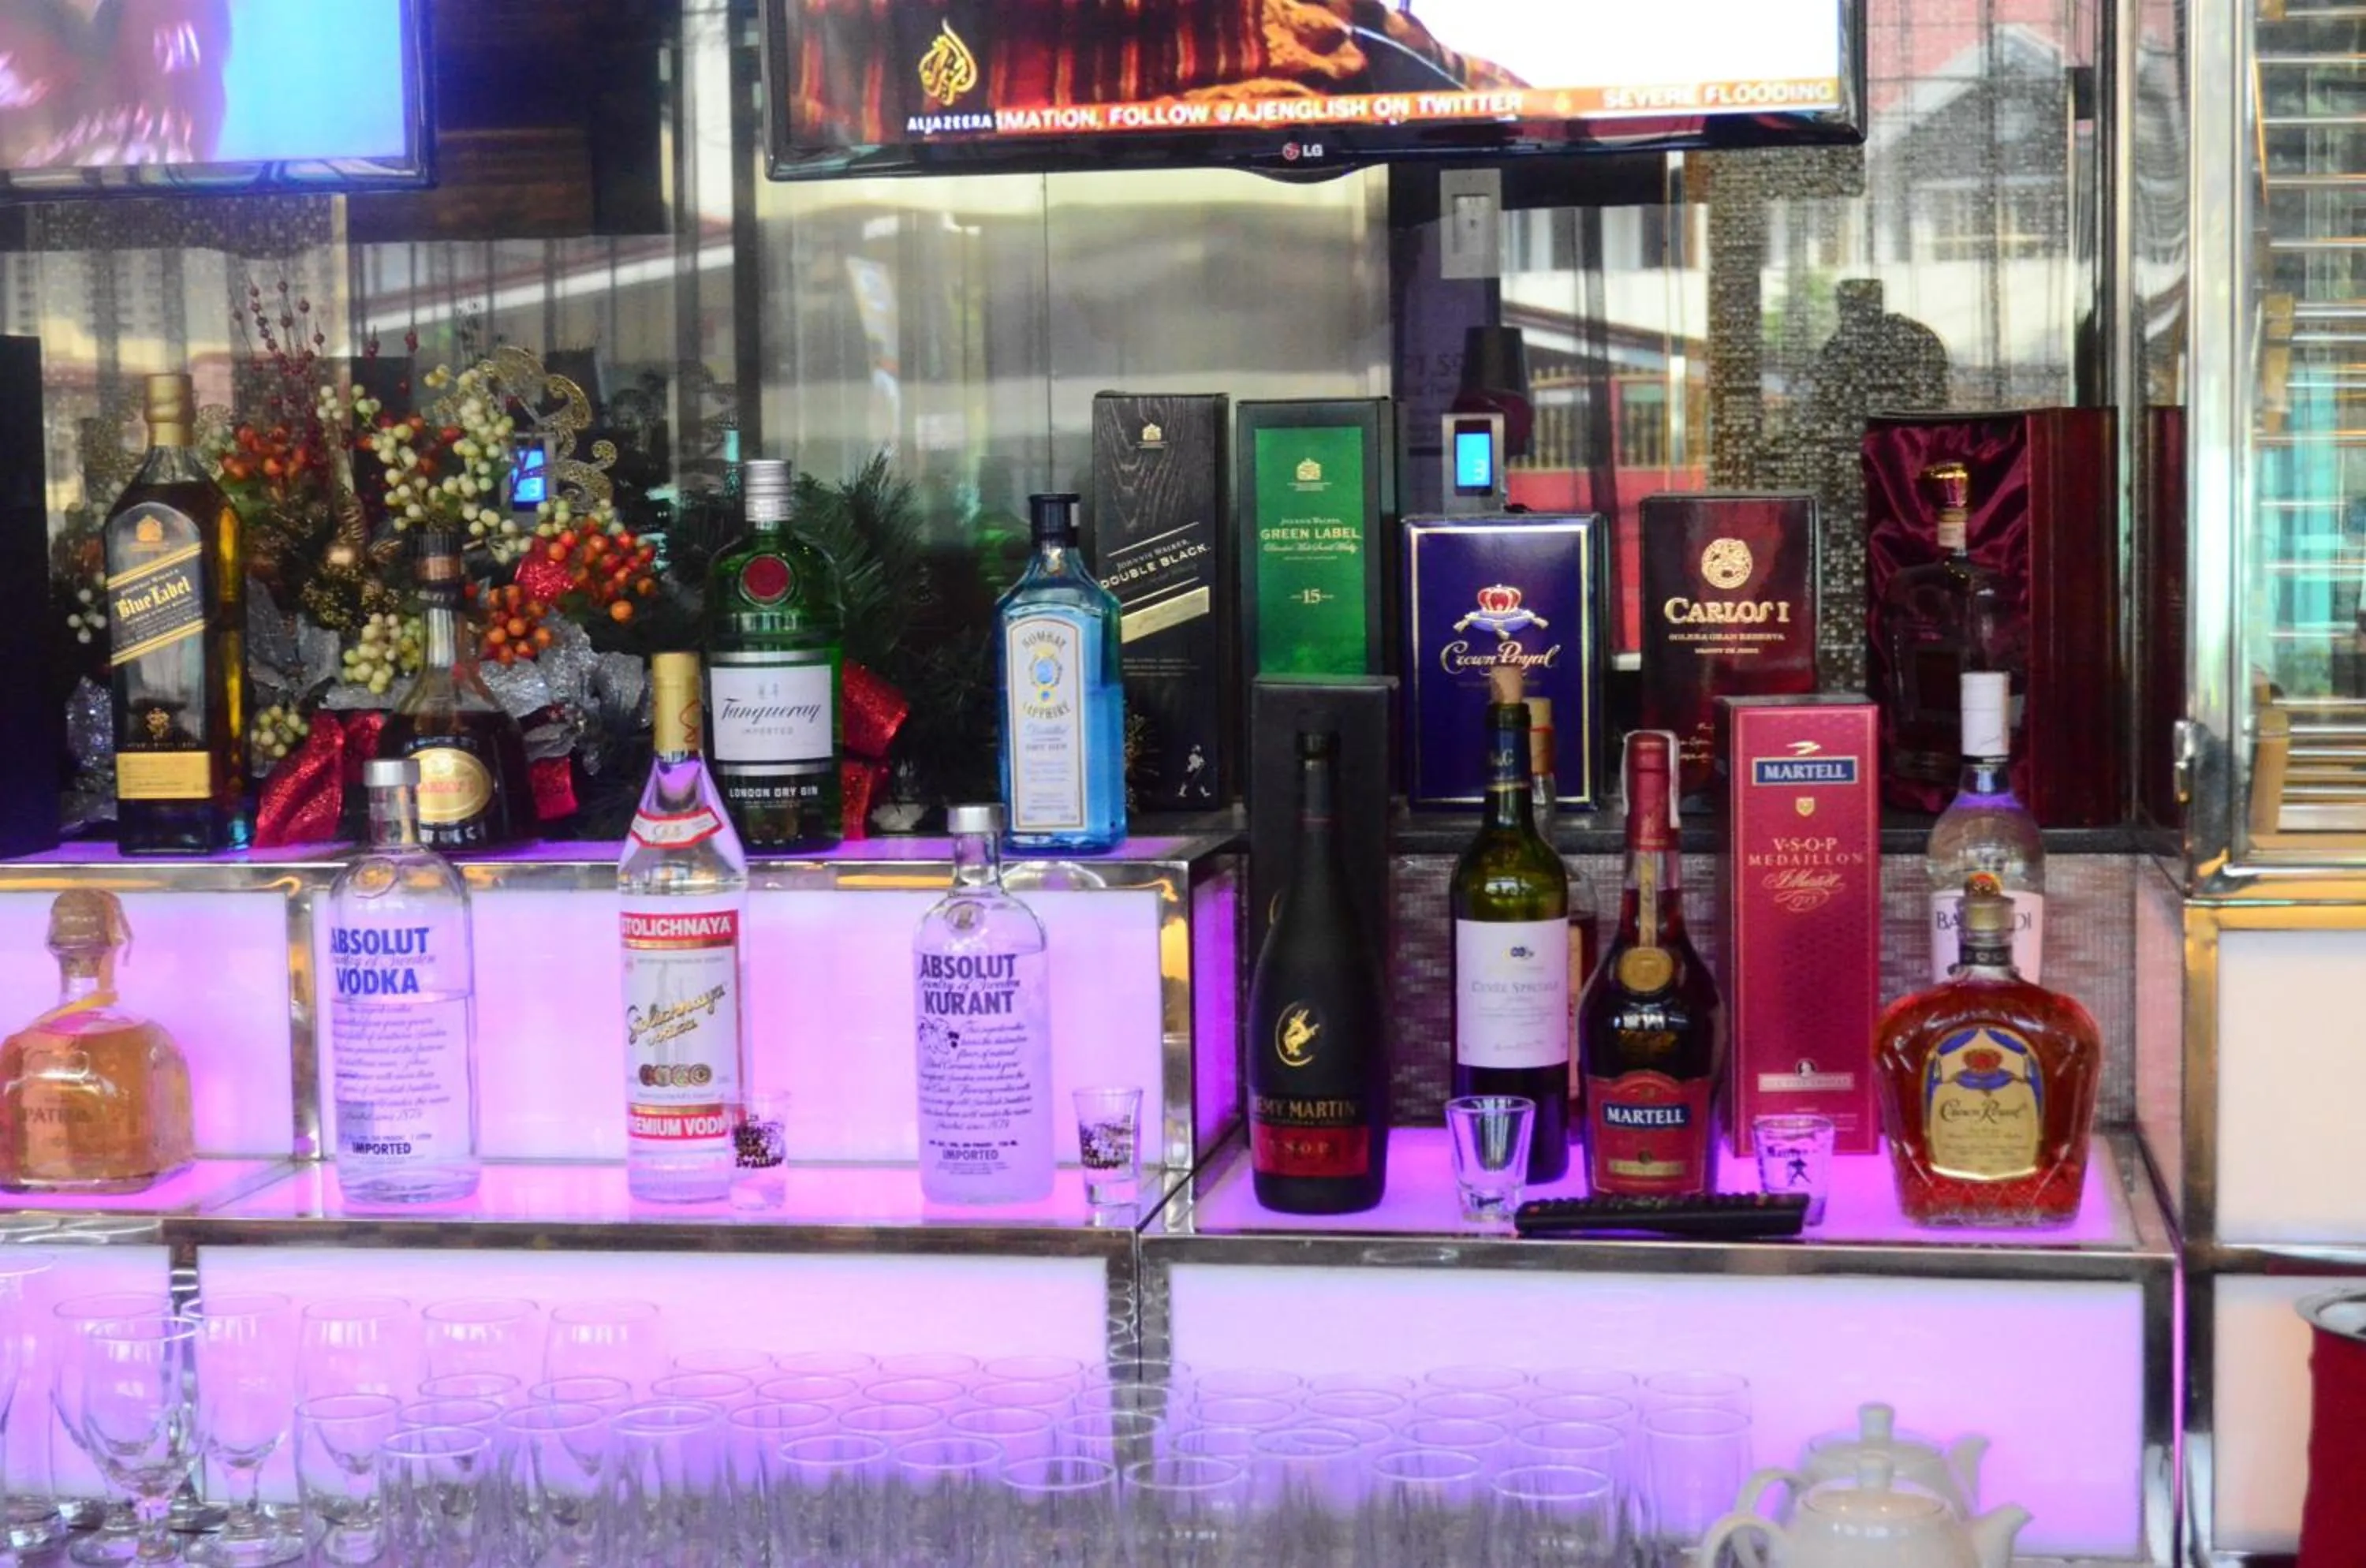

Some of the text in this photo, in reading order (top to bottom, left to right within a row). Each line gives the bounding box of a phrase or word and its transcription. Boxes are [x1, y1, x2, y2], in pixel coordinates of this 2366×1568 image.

[1109, 103, 1209, 126] FOLLOW
[1372, 96, 1410, 117] ON
[1416, 91, 1524, 114] TWITTER
[1602, 86, 1695, 108] SEVERE
[1704, 82, 1833, 104] FLOODING
[1302, 144, 1323, 157] LG
[1260, 527, 1362, 540] GREEN LABEL
[1099, 562, 1157, 590] DOUBLE
[114, 595, 152, 621] Blue
[149, 576, 192, 607] Label
[1302, 589, 1321, 604] 15
[1439, 640, 1561, 674] Crown Royal
[721, 697, 821, 724] Tanqueray
[1763, 763, 1847, 779] MARTELL
[730, 786, 819, 798] LONDON DRY GIN
[1747, 853, 1864, 866] MEDAILLON
[330, 927, 430, 955] ABSOLUT
[920, 953, 1018, 979] ABSOLUT
[336, 967, 420, 995] VODKA
[924, 990, 1015, 1015] KURANT
[1289, 1099, 1357, 1118] MARTIN
[1607, 1107, 1685, 1124] MARTELL
[353, 1141, 412, 1155] IMPORTED
[942, 1148, 999, 1160] IMPORTED
